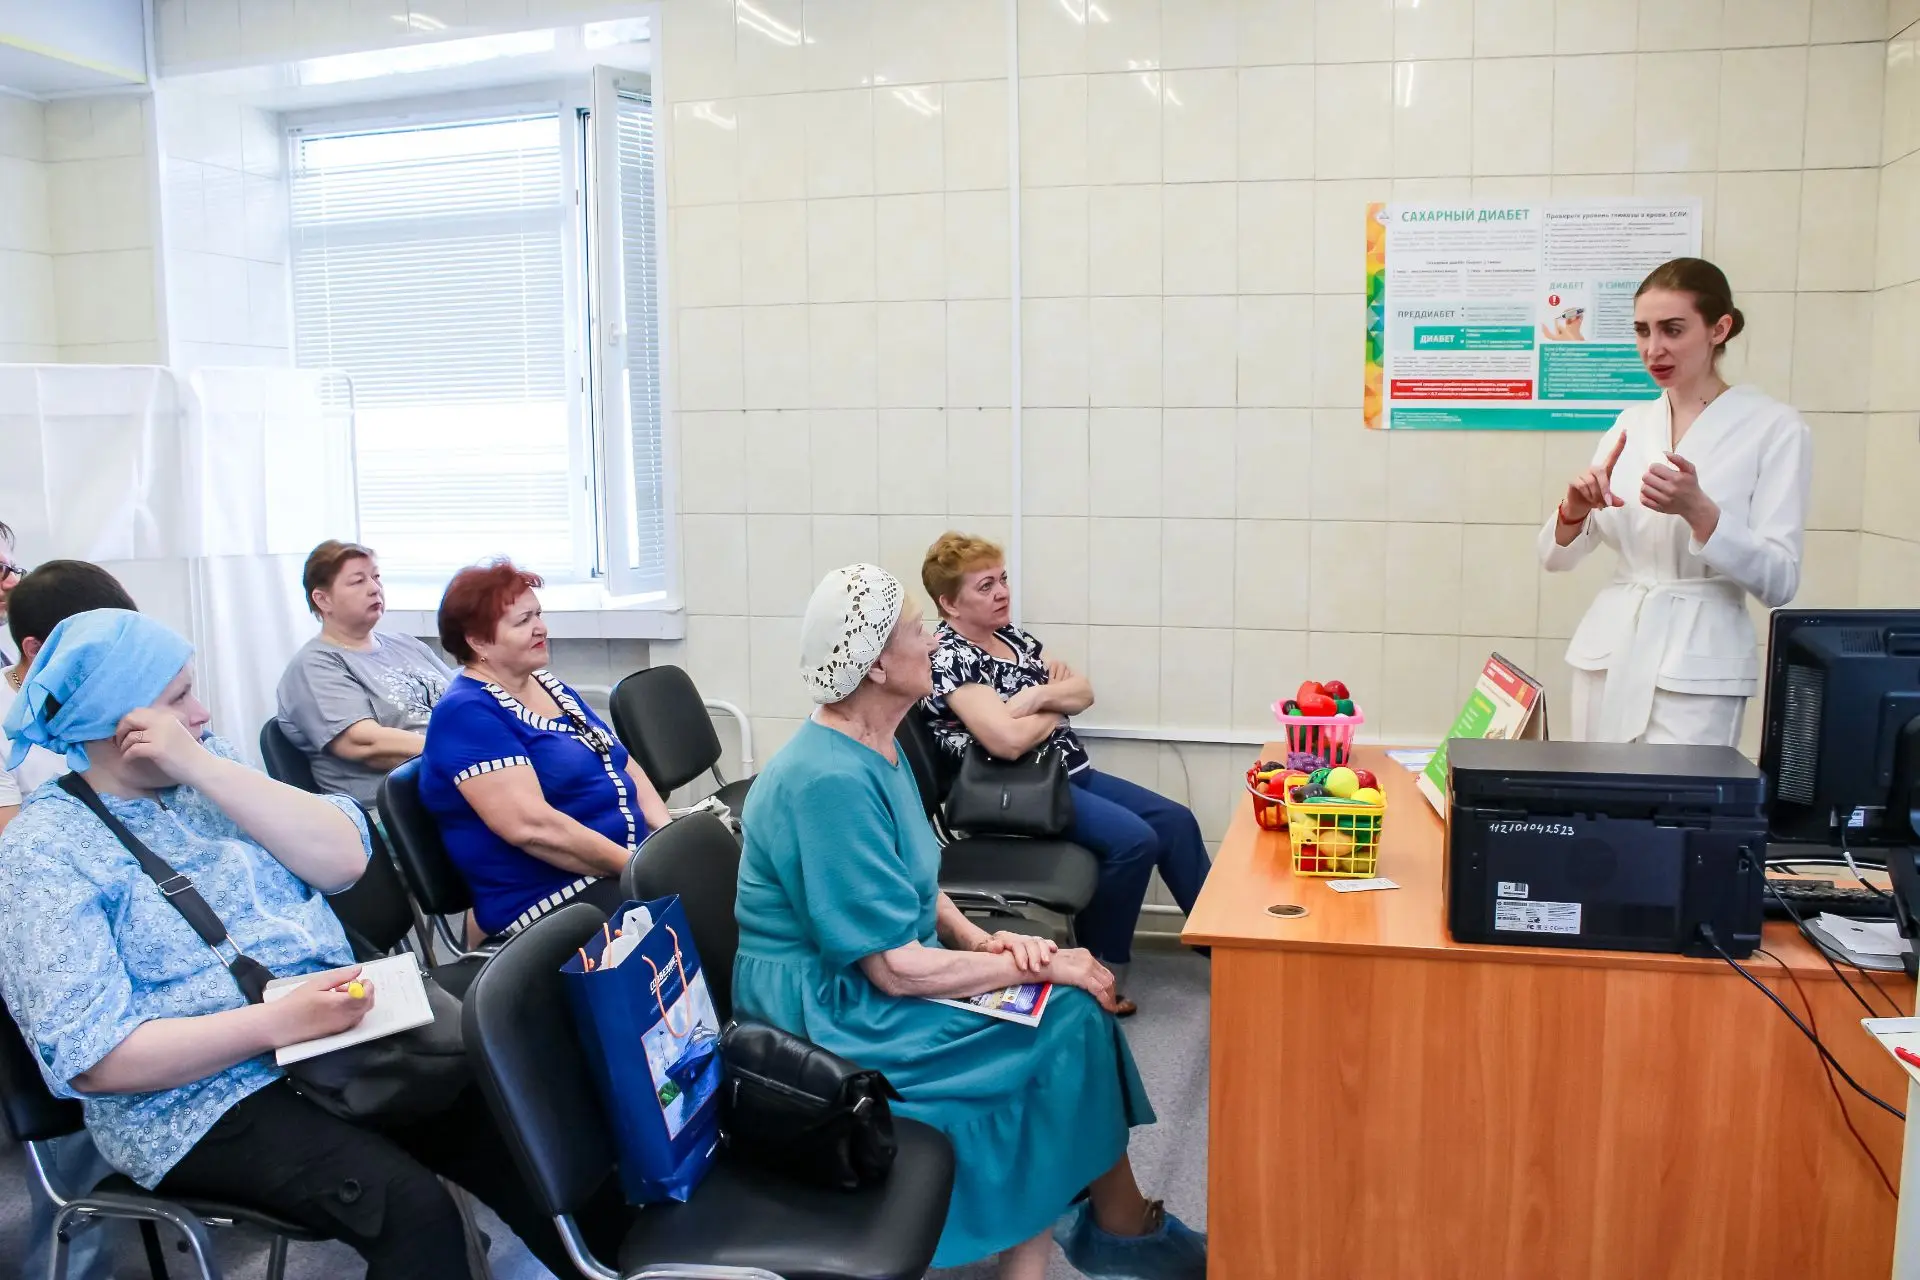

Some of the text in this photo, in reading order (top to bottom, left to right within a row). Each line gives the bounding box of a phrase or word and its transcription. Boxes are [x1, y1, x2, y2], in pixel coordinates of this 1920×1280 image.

[1401, 208, 1530, 223] САХАРНЫЙ ДИАБЕТ
[1549, 281, 1584, 290] ДИАБЕТ
[1397, 310, 1456, 319] ПРЕДДИАБЕТ
[1419, 334, 1456, 344] ДИАБЕТ
